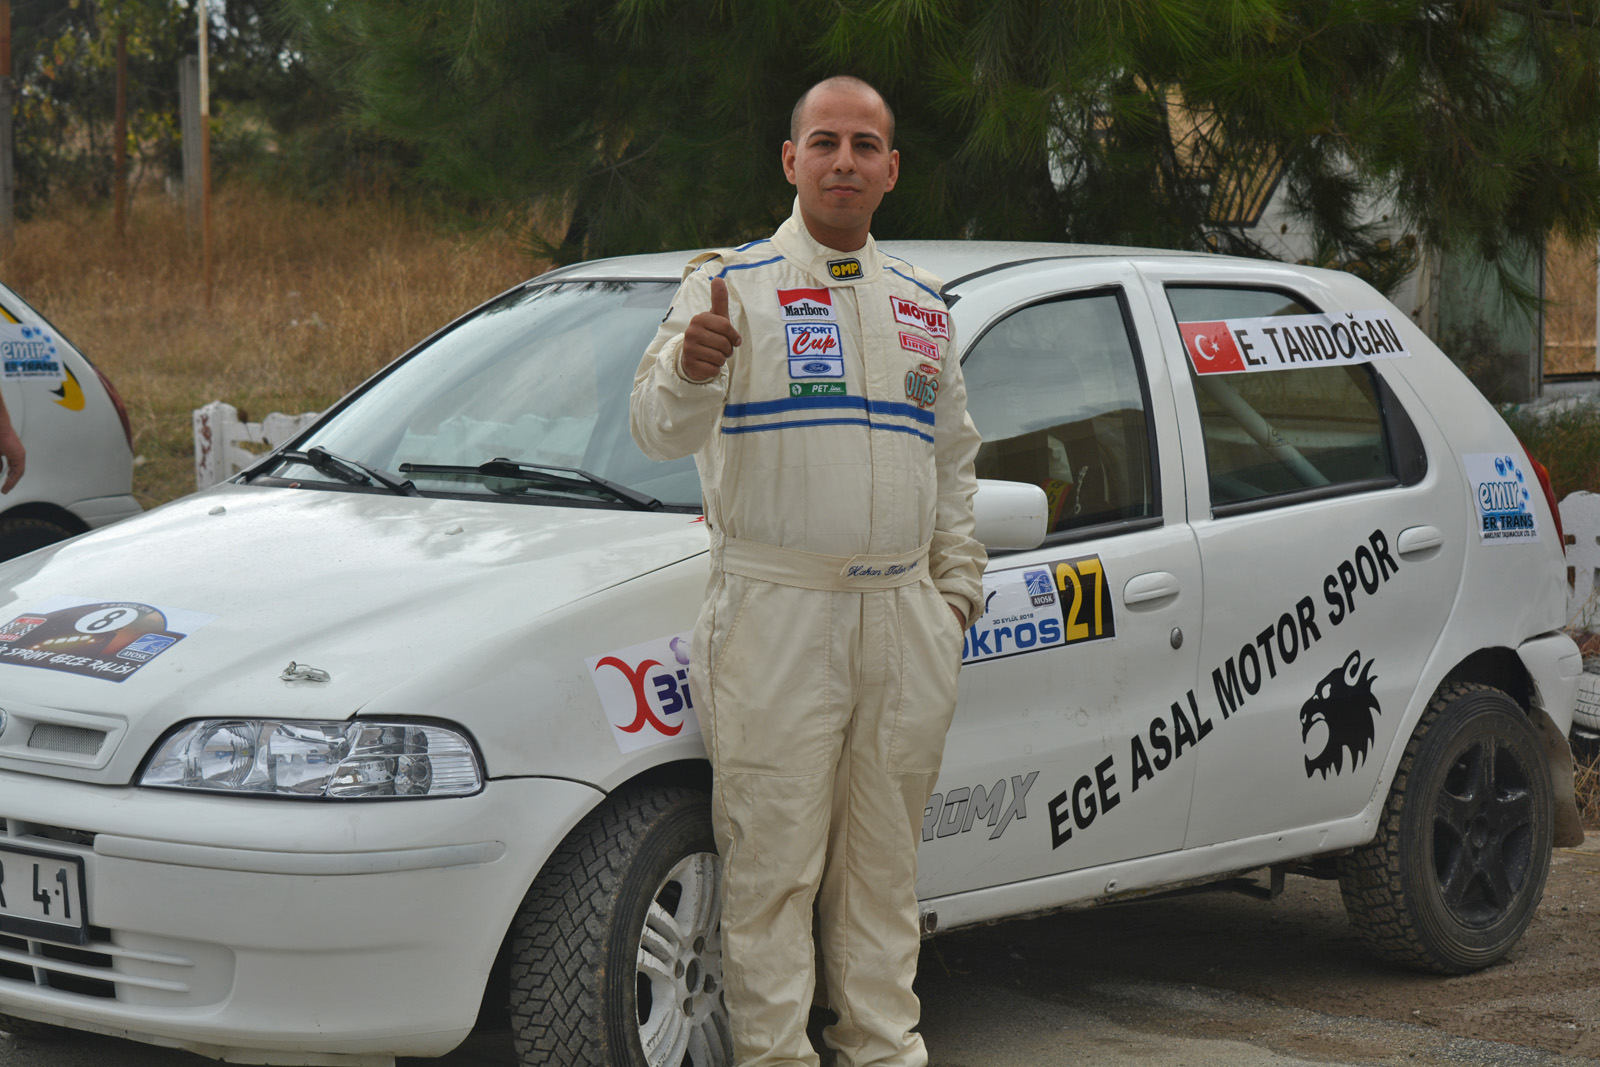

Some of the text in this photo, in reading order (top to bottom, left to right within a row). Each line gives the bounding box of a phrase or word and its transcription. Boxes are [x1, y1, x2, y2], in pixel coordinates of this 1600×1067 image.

[831, 262, 859, 277] OMP
[783, 302, 829, 317] Marlboro
[898, 301, 946, 328] MOTUL
[791, 326, 833, 335] ESCORT
[1234, 312, 1405, 366] E. TANDOĞAN
[792, 331, 837, 355] Cup
[902, 334, 938, 358] PIRELLI
[811, 384, 829, 393] PET
[906, 371, 939, 408] Olips
[1482, 513, 1534, 531] ER TRANS
[847, 565, 882, 577] Hakan
[1033, 595, 1054, 606] AYOSK
[1056, 558, 1103, 641] 27
[86, 609, 127, 631] 8
[3, 648, 56, 661] SPRINT
[49, 653, 92, 666] GECE
[121, 650, 149, 660] AYOSK
[1047, 529, 1399, 850] EGE ASAL MOTOR SPOR
[33, 863, 71, 919] 41
